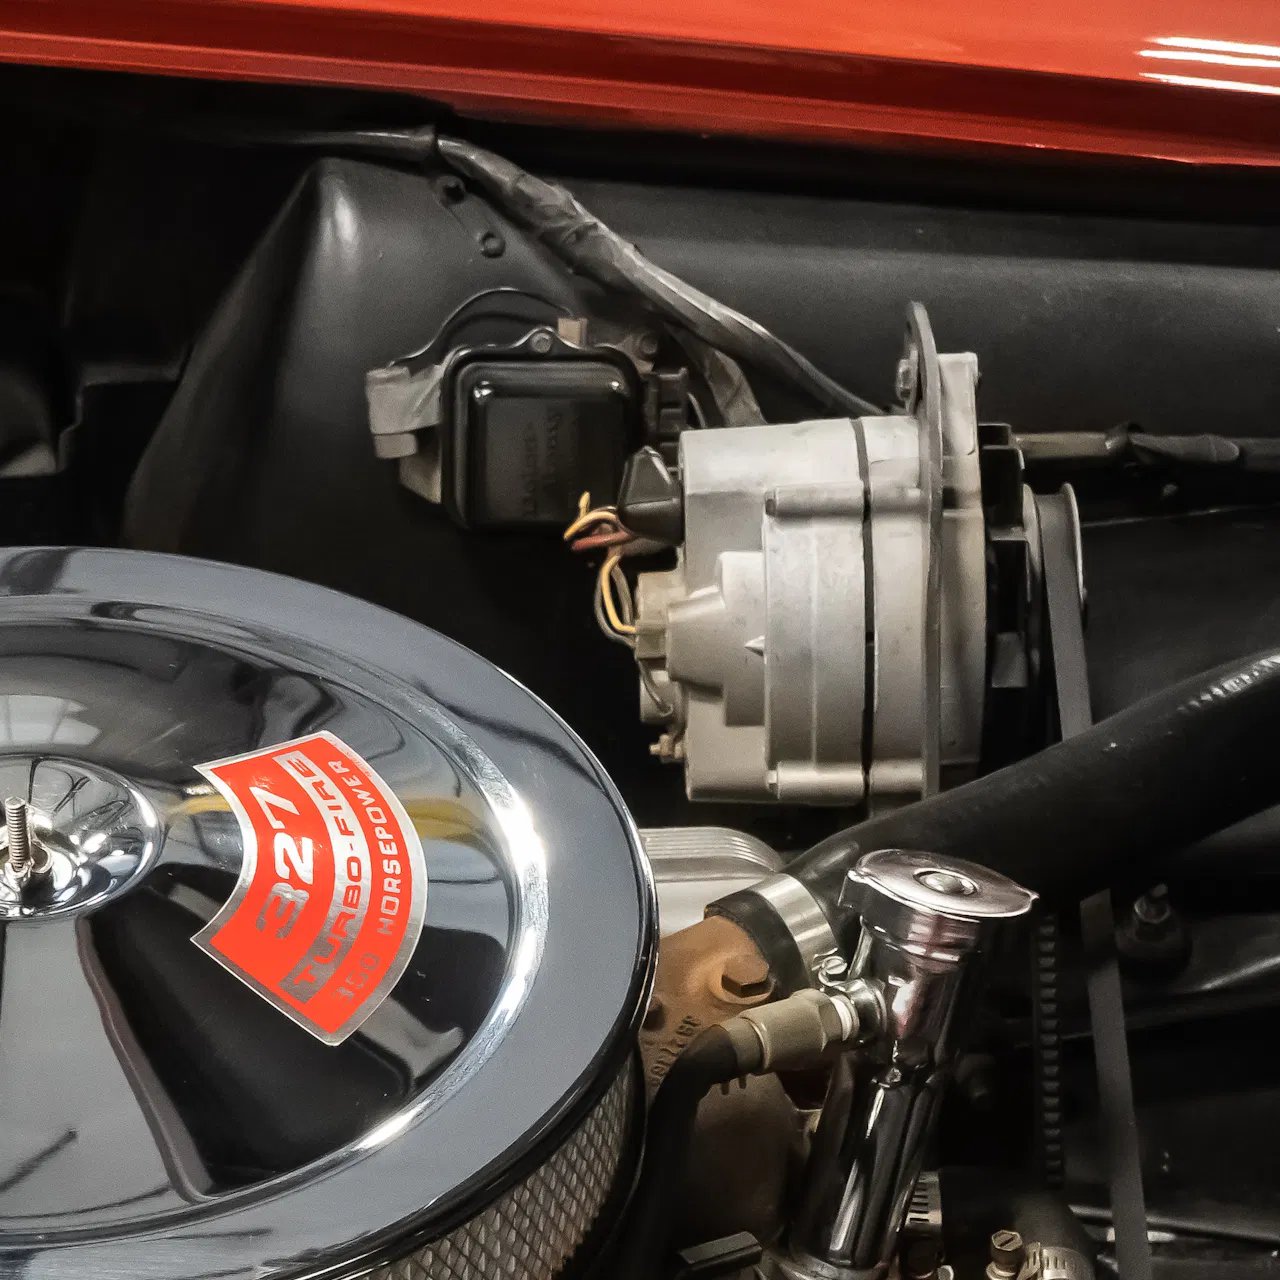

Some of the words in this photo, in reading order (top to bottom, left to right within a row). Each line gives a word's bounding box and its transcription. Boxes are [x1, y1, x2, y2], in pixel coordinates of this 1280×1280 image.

[249, 786, 314, 939] 327
[286, 757, 363, 986] TURBO-FIRE
[328, 759, 403, 936] HORSEPOWER
[331, 952, 382, 1005] 350
